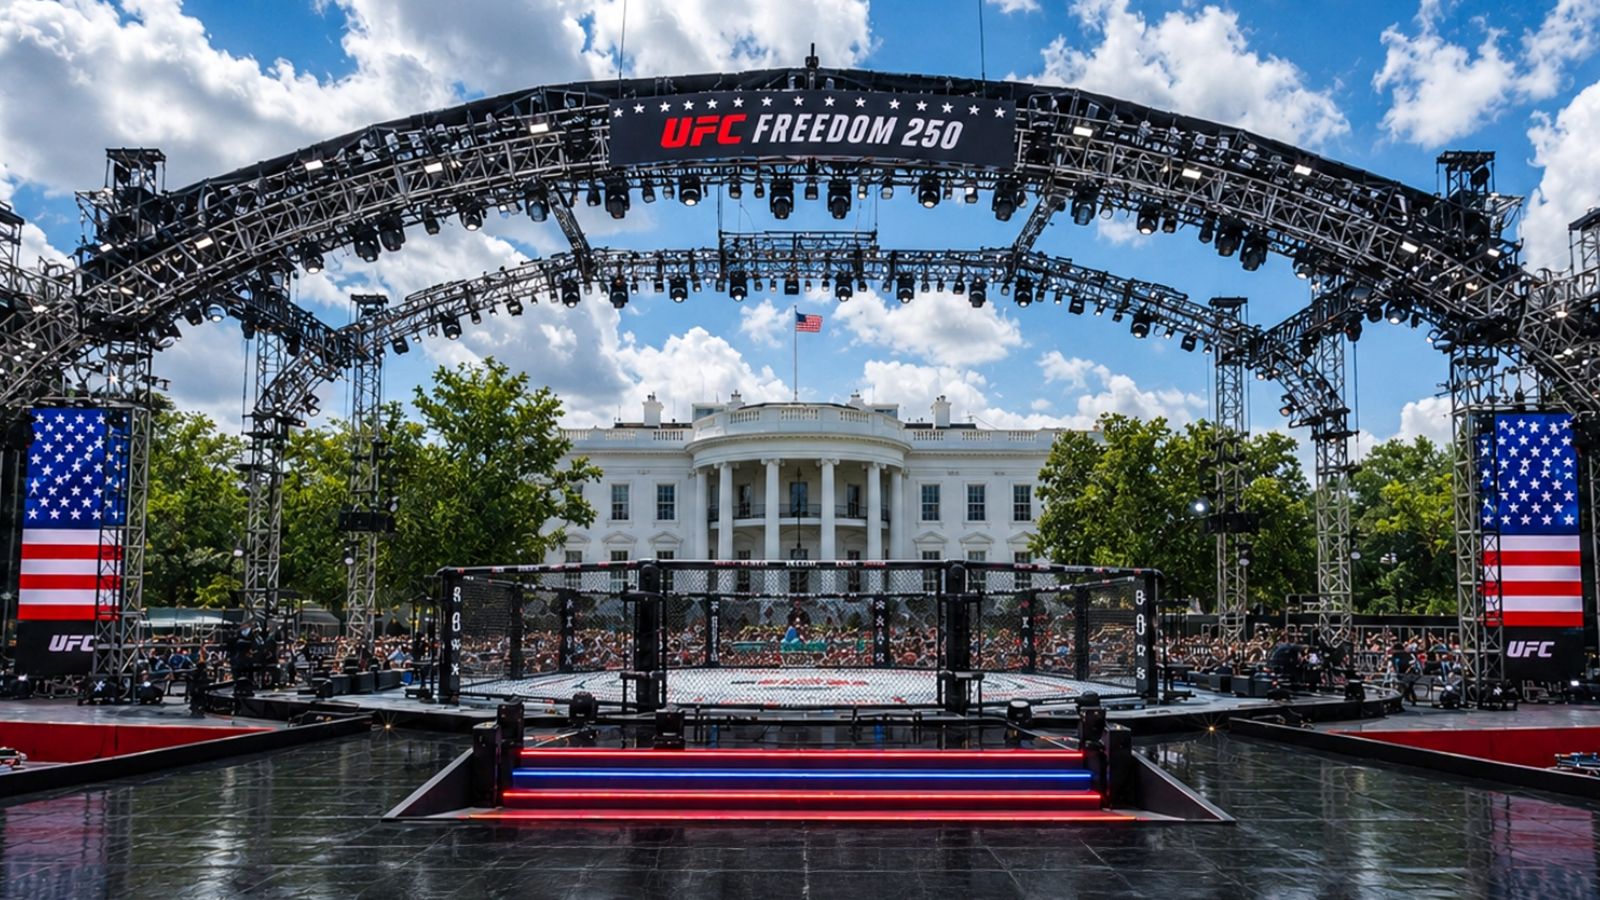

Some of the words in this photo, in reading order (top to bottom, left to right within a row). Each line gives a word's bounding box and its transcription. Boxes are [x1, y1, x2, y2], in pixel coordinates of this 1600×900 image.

[661, 114, 747, 148] UFC
[752, 113, 898, 145] FREEDOM
[901, 118, 964, 149] 250
[48, 635, 95, 651] UFC
[1507, 641, 1555, 657] UFC
